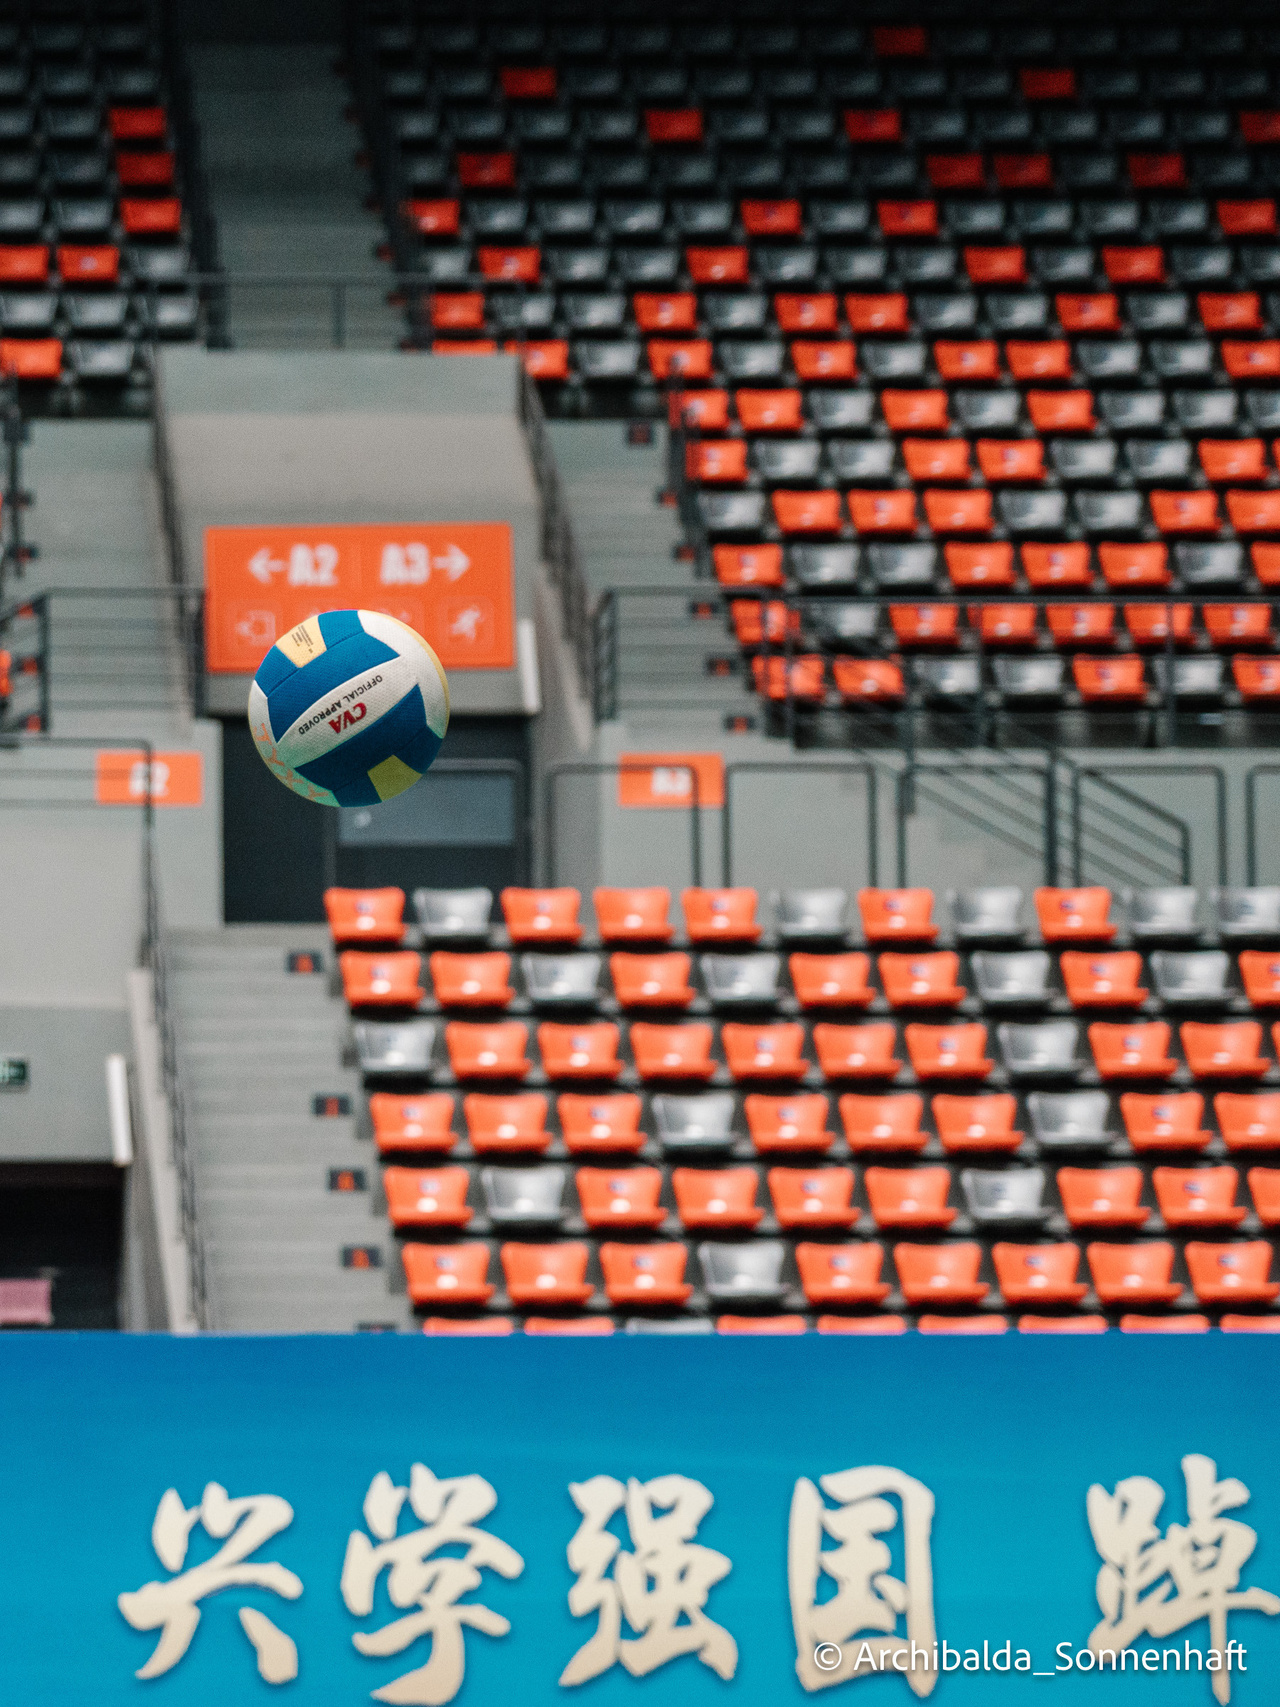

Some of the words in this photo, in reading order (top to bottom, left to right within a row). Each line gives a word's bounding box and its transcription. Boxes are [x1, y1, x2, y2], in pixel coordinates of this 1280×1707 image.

[288, 543, 339, 586] A2
[380, 542, 430, 585] A3
[343, 674, 383, 703] OFFICIAL
[298, 700, 342, 735] APPROVED
[328, 702, 367, 734] CVA
